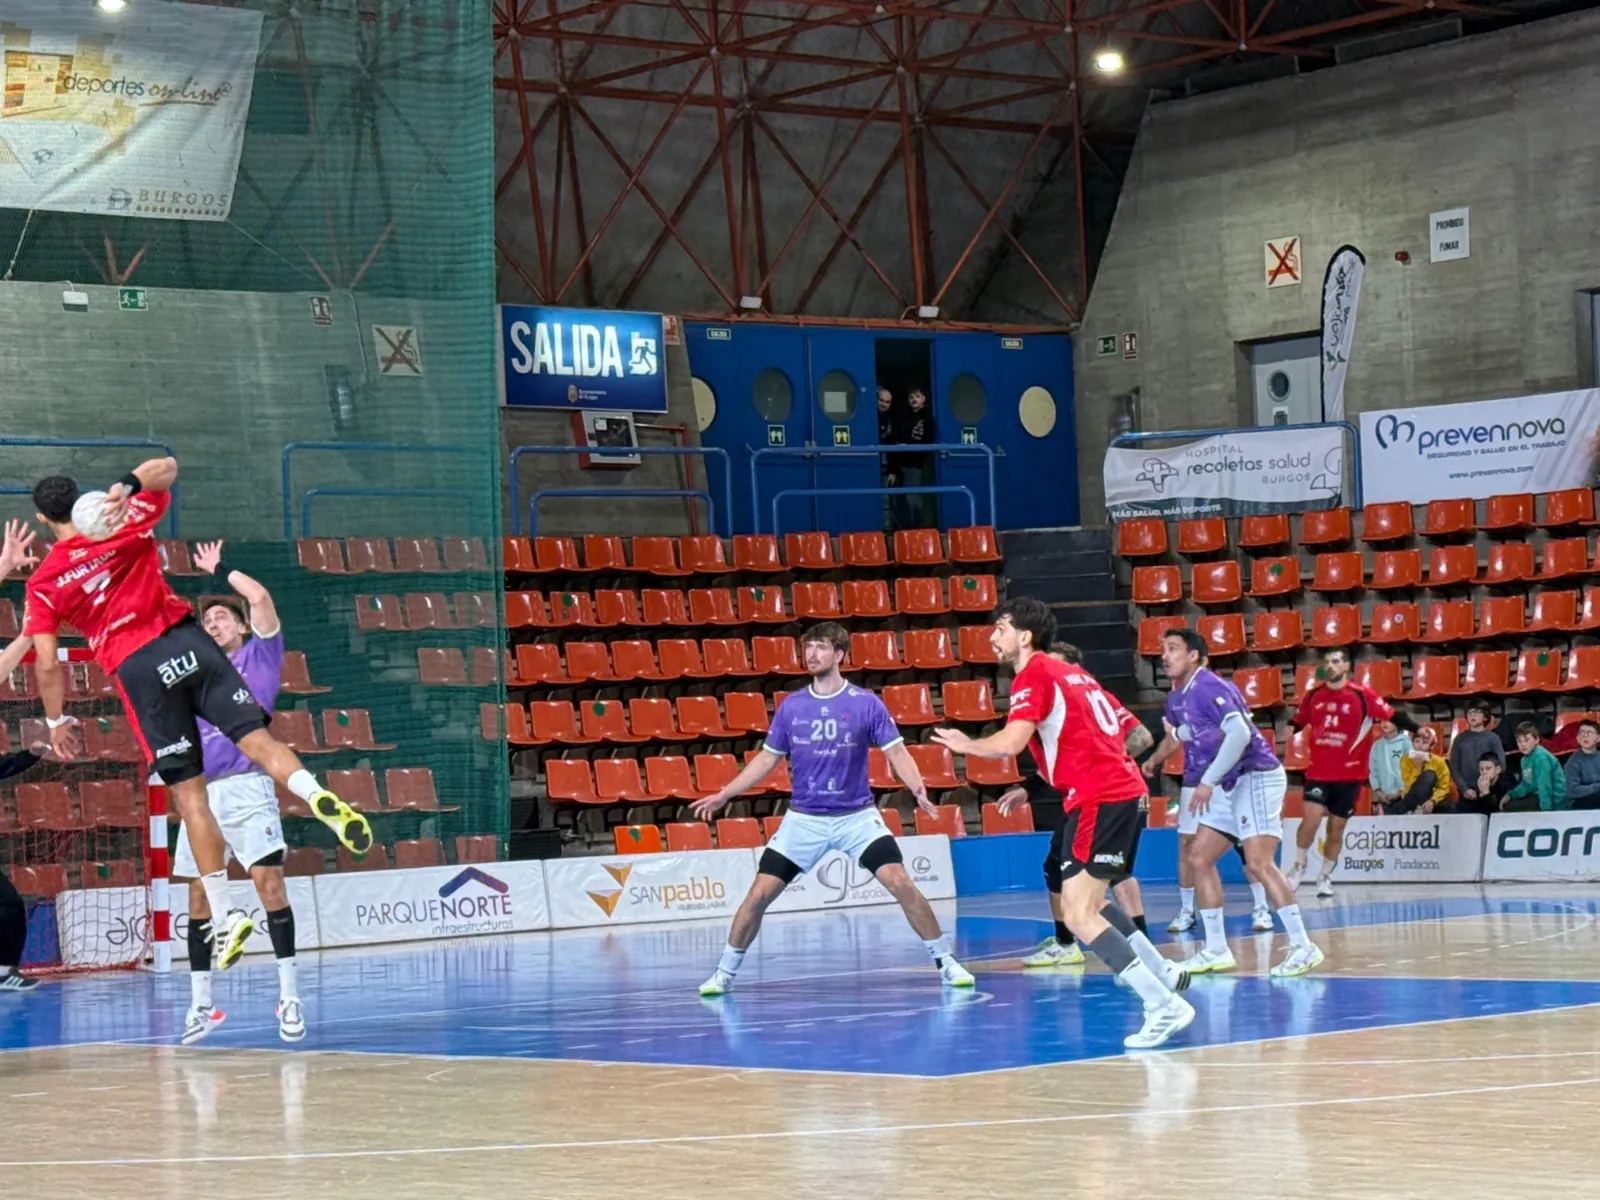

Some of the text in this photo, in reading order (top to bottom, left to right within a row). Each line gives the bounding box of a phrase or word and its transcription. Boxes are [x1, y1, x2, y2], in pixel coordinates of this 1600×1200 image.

[63, 73, 145, 96] deportes
[138, 189, 229, 207] BURGOS
[510, 321, 625, 378] SALIDA
[1418, 417, 1566, 455] prevennova
[1186, 445, 1244, 458] HOSPITAL
[1427, 449, 1472, 459] SEGURIDAD
[1481, 446, 1506, 455] SALUD
[1508, 444, 1519, 452] EN
[1521, 443, 1530, 451] EL
[1532, 439, 1566, 449] TRABAJO
[1187, 451, 1311, 476] recoletas salud
[1262, 473, 1312, 485] BURGOS
[81, 569, 111, 607] 7
[811, 719, 837, 741] 20
[1345, 824, 1440, 856] cajarural
[1344, 857, 1440, 873] Burgos Fundación
[630, 876, 726, 909] SANpablo
[356, 894, 513, 926] PARQUENORTE
[432, 919, 514, 934] infraestructuras
